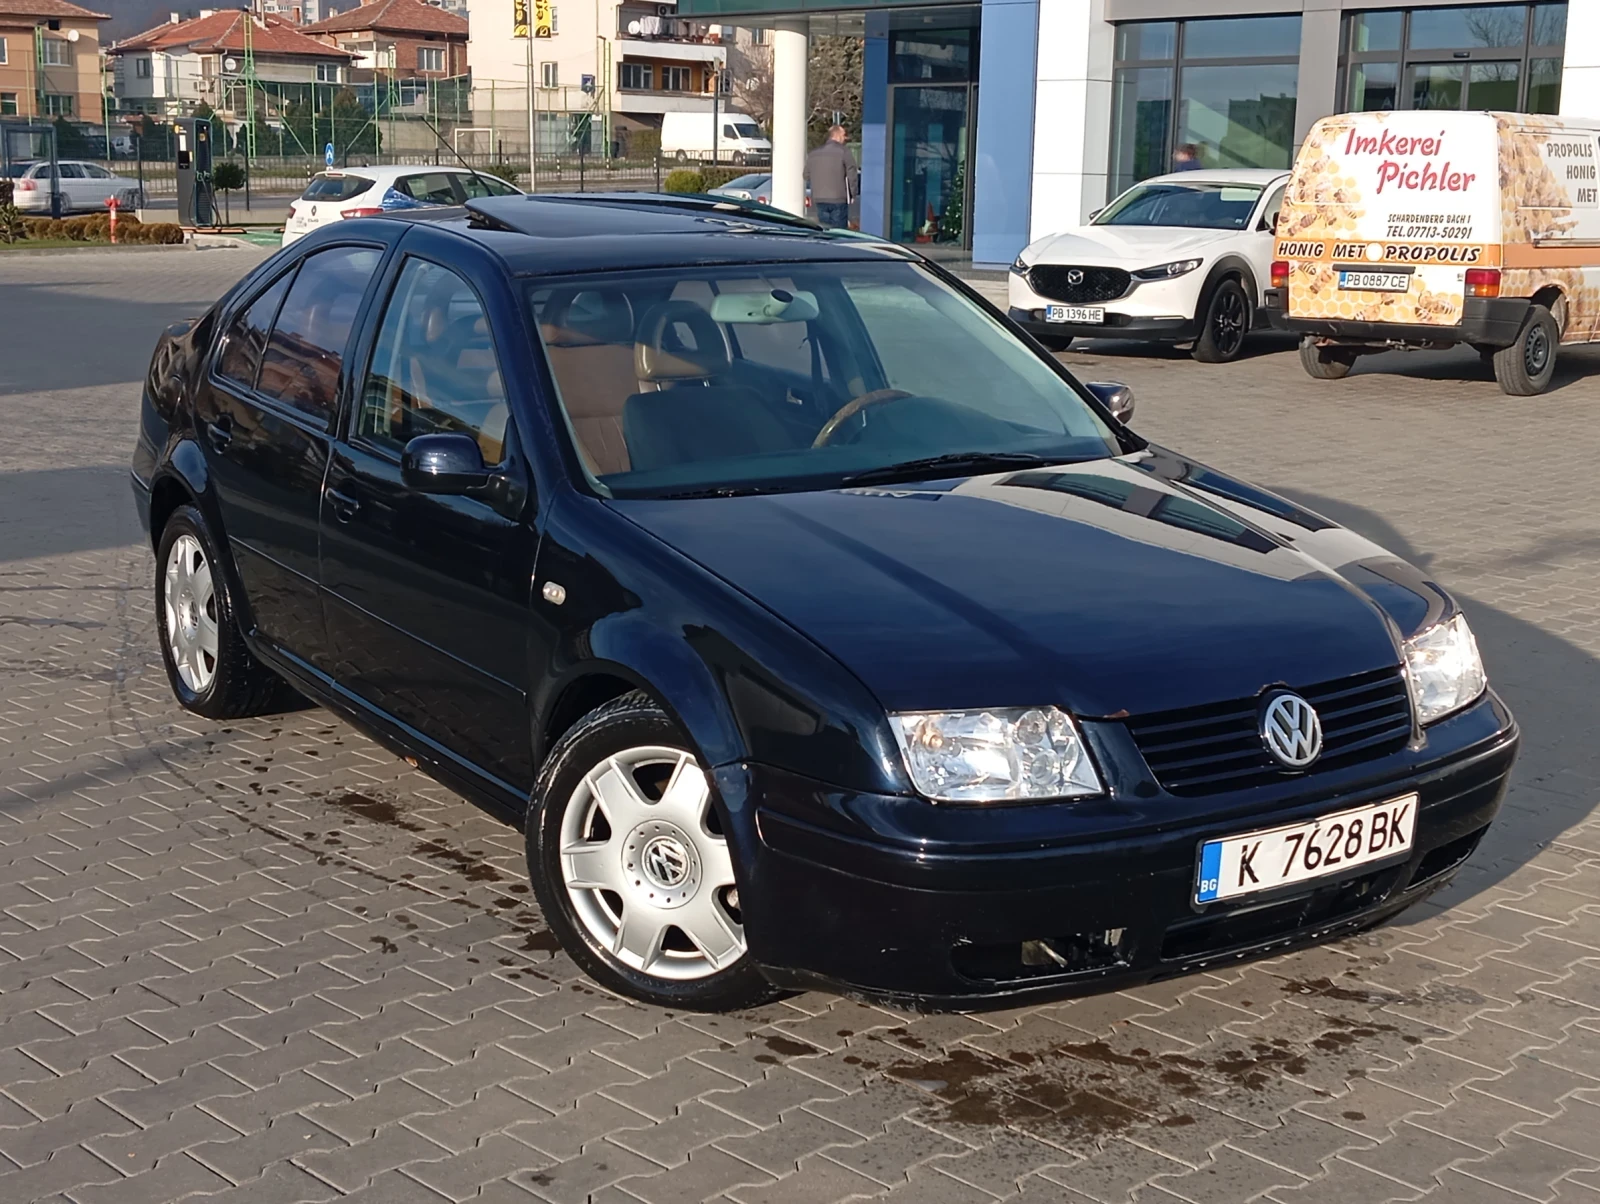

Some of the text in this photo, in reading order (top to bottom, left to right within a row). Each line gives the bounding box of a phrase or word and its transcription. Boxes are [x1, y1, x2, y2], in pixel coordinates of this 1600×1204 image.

[1345, 128, 1445, 156] Imkerei
[1547, 143, 1592, 158] PROPOLIS
[1376, 160, 1475, 194] Pichler
[1566, 165, 1596, 179] HONIG
[1577, 188, 1597, 202] MET
[1387, 213, 1444, 224] SCHARDENBERG
[1386, 226, 1472, 239] TEL.07713-50291
[1278, 242, 1480, 262] HONIG MET PROPOLIS
[1346, 274, 1407, 288] PB 0887 CE
[1052, 308, 1101, 320] PB 1396 HE
[1200, 878, 1217, 893] BG
[1238, 841, 1261, 887] K
